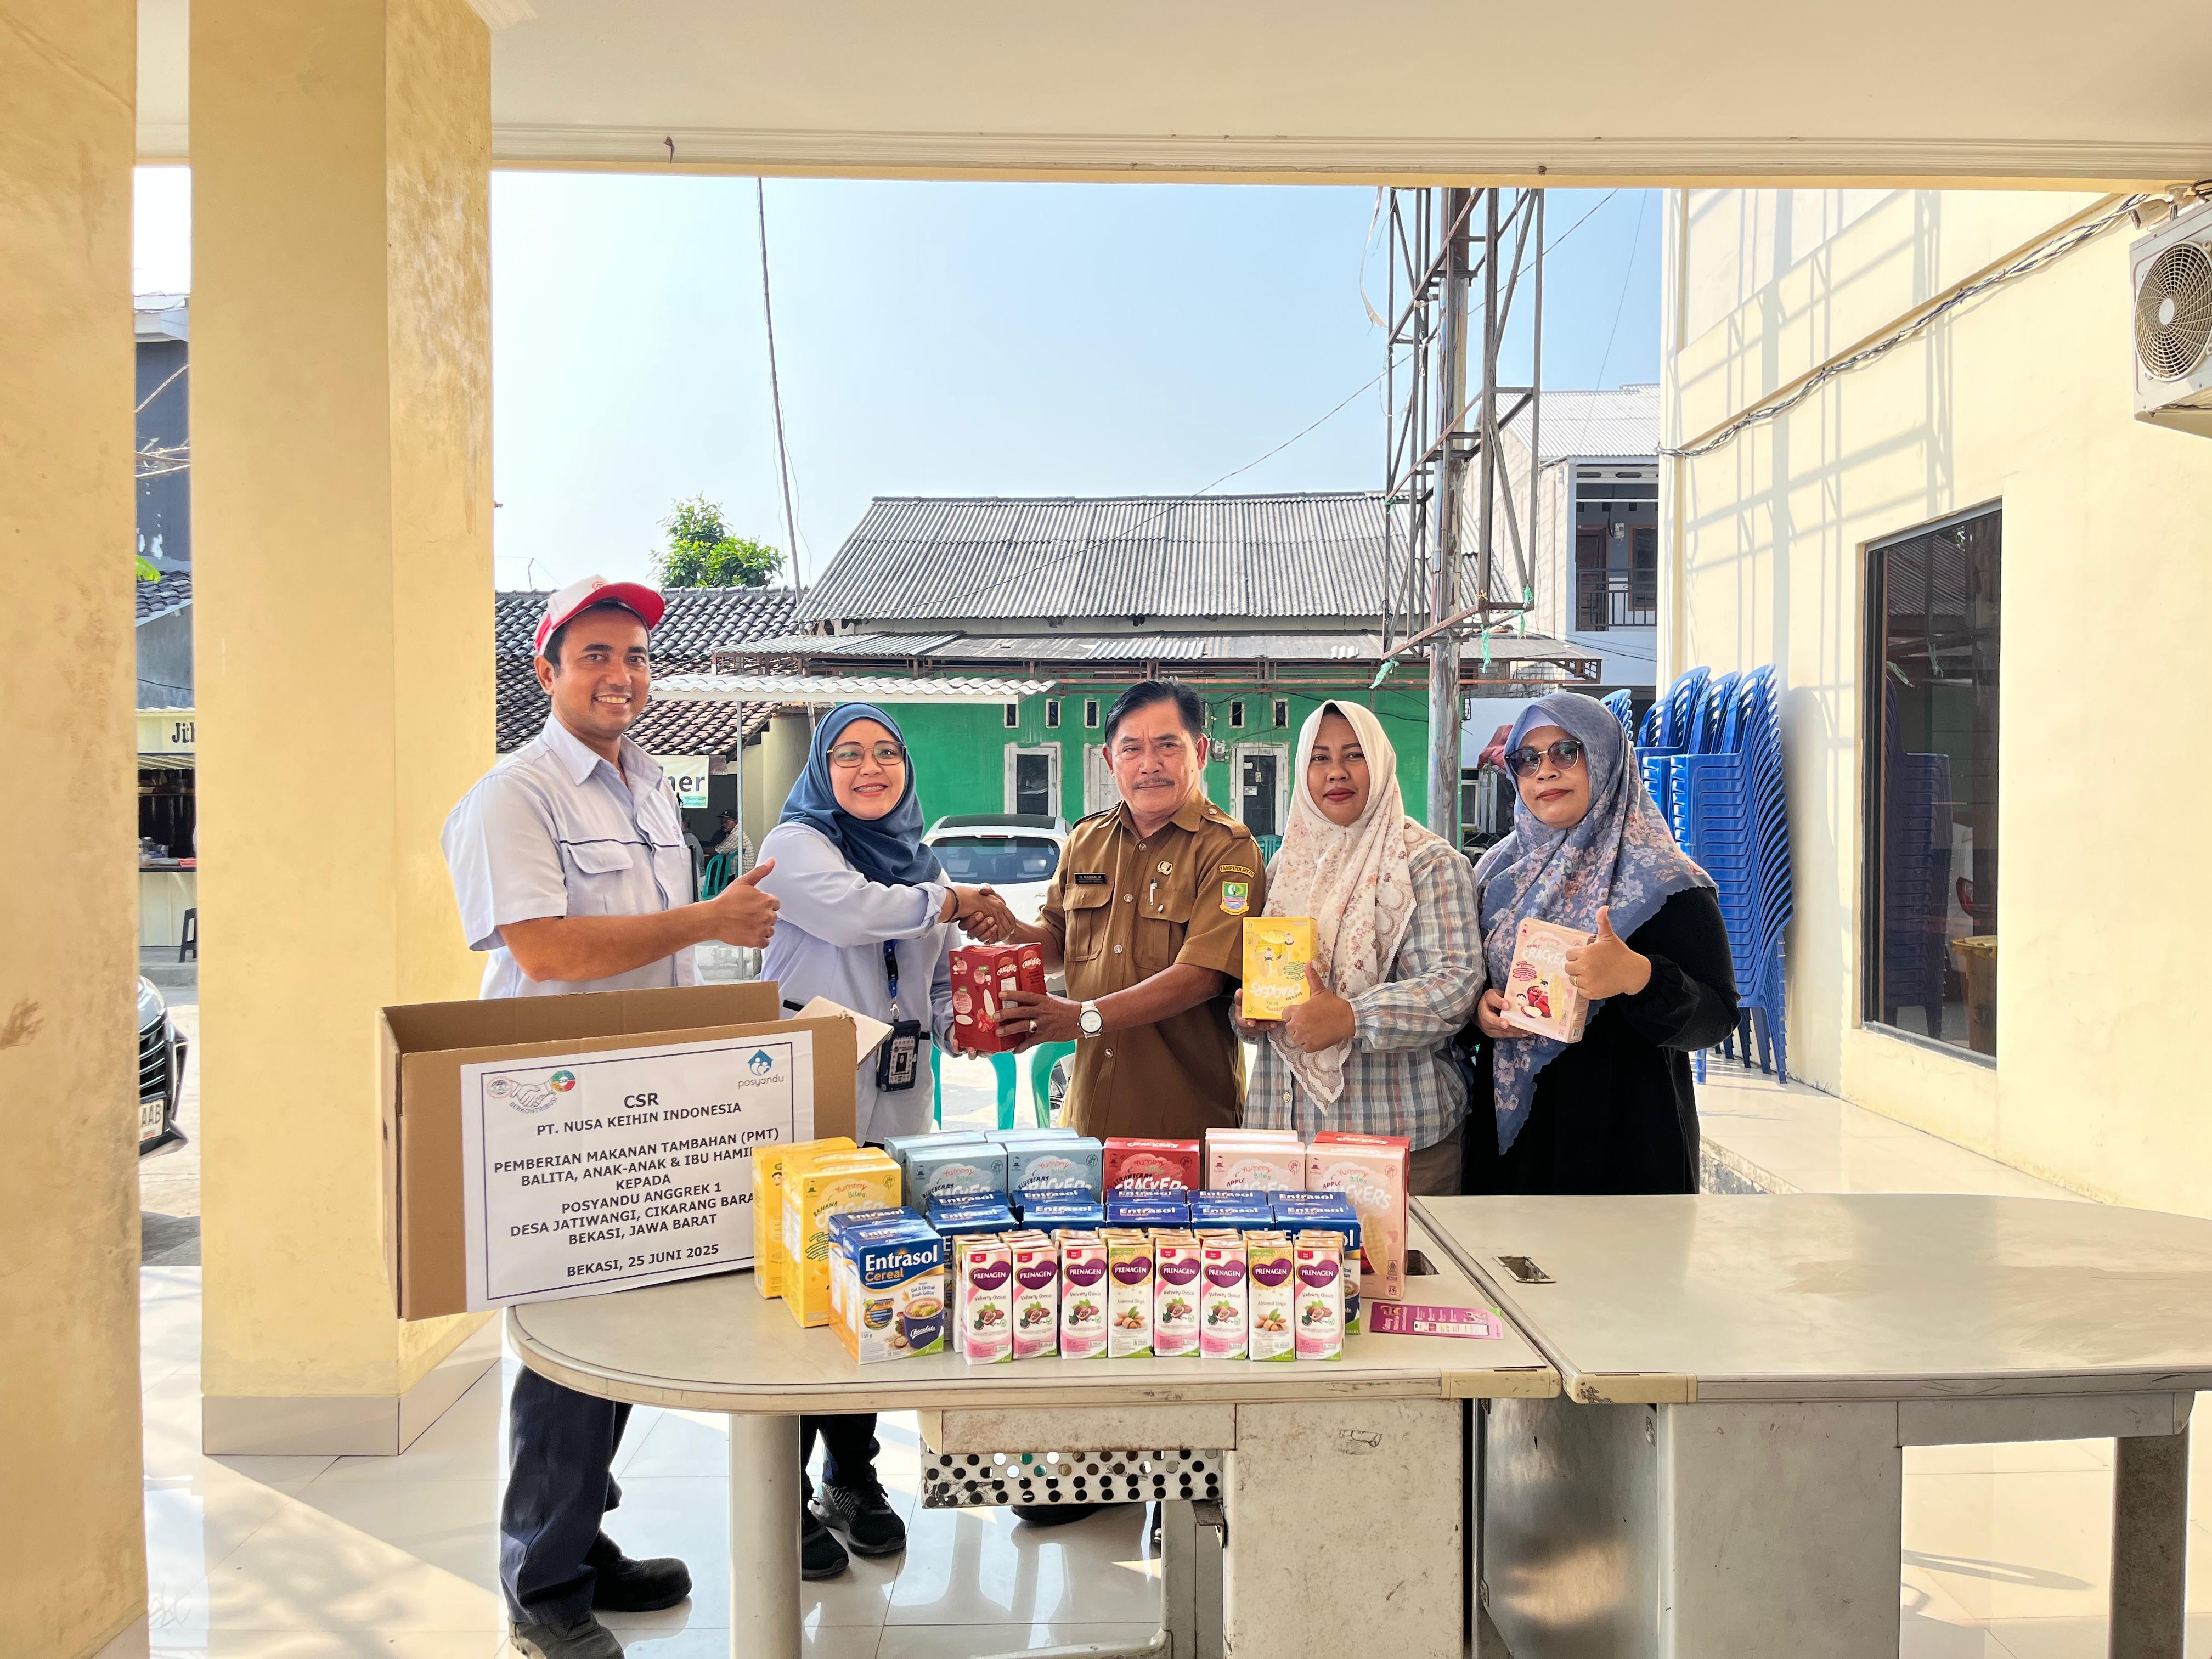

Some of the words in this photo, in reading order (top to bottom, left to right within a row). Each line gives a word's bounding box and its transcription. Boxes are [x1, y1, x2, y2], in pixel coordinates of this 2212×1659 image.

[1250, 981, 1301, 1000] CRACKERS
[738, 1074, 784, 1089] posyandu
[509, 1097, 557, 1114] BERKONTRIBUSI
[624, 1093, 659, 1108] CSR
[537, 1124, 558, 1136] PT.
[563, 1118, 603, 1133] NUSA
[607, 1111, 659, 1128] KEIHIN
[663, 1102, 741, 1121] INDONESIA
[1336, 1137, 1389, 1145] CRACKERS
[494, 1153, 582, 1173] PEMBERIAN
[587, 1144, 657, 1163] MAKANAN
[661, 1133, 737, 1153] TAMBAHAN
[741, 1127, 779, 1145] (PMT)
[522, 1170, 579, 1187] BALITA,
[583, 1158, 667, 1179] ANAK-ANAK
[671, 1156, 681, 1167] &
[685, 1152, 709, 1166] IBU
[1039, 1161, 1070, 1170] Yummy
[1134, 1159, 1166, 1167] Yummy
[1241, 1166, 1272, 1175] Yummy
[943, 1168, 974, 1177] Yummy
[1337, 1169, 1368, 1177] Yummy
[1350, 1176, 1367, 1184] Bites
[616, 1174, 671, 1190] KEPADA
[835, 1183, 867, 1193] Yummy
[1018, 1175, 1049, 1189] BLUEBERRY
[1227, 1178, 1246, 1187] APPLE
[1323, 1181, 1341, 1189] APPLE
[561, 1193, 640, 1214] POSYANDU
[644, 1183, 710, 1203] ANGGREK
[714, 1182, 722, 1193] 1
[922, 1183, 954, 1199] BLUEBERRY
[939, 1194, 994, 1204] Entrasol
[511, 1222, 549, 1237] DESA
[553, 1210, 641, 1232] JATIWANGI,
[645, 1198, 717, 1218] CIKARANG
[720, 1192, 753, 1207] BARA
[814, 1201, 838, 1216] BANANA
[847, 1209, 904, 1220] Entrasol
[940, 1209, 998, 1220] Entrasol
[569, 1228, 625, 1245] BEKASI,
[629, 1221, 669, 1236] JAWA
[673, 1213, 718, 1230] BARAT
[567, 1259, 623, 1277] BEKASI,
[628, 1255, 645, 1268] 25
[648, 1249, 681, 1264] JUNI
[686, 1244, 719, 1259] 2025
[865, 1245, 938, 1272] Entrasol
[865, 1268, 905, 1283] Cereal
[1020, 1271, 1052, 1279] PRENAGEN
[1209, 1269, 1240, 1277] PRENAGEN
[910, 1325, 936, 1340] Chocolate
